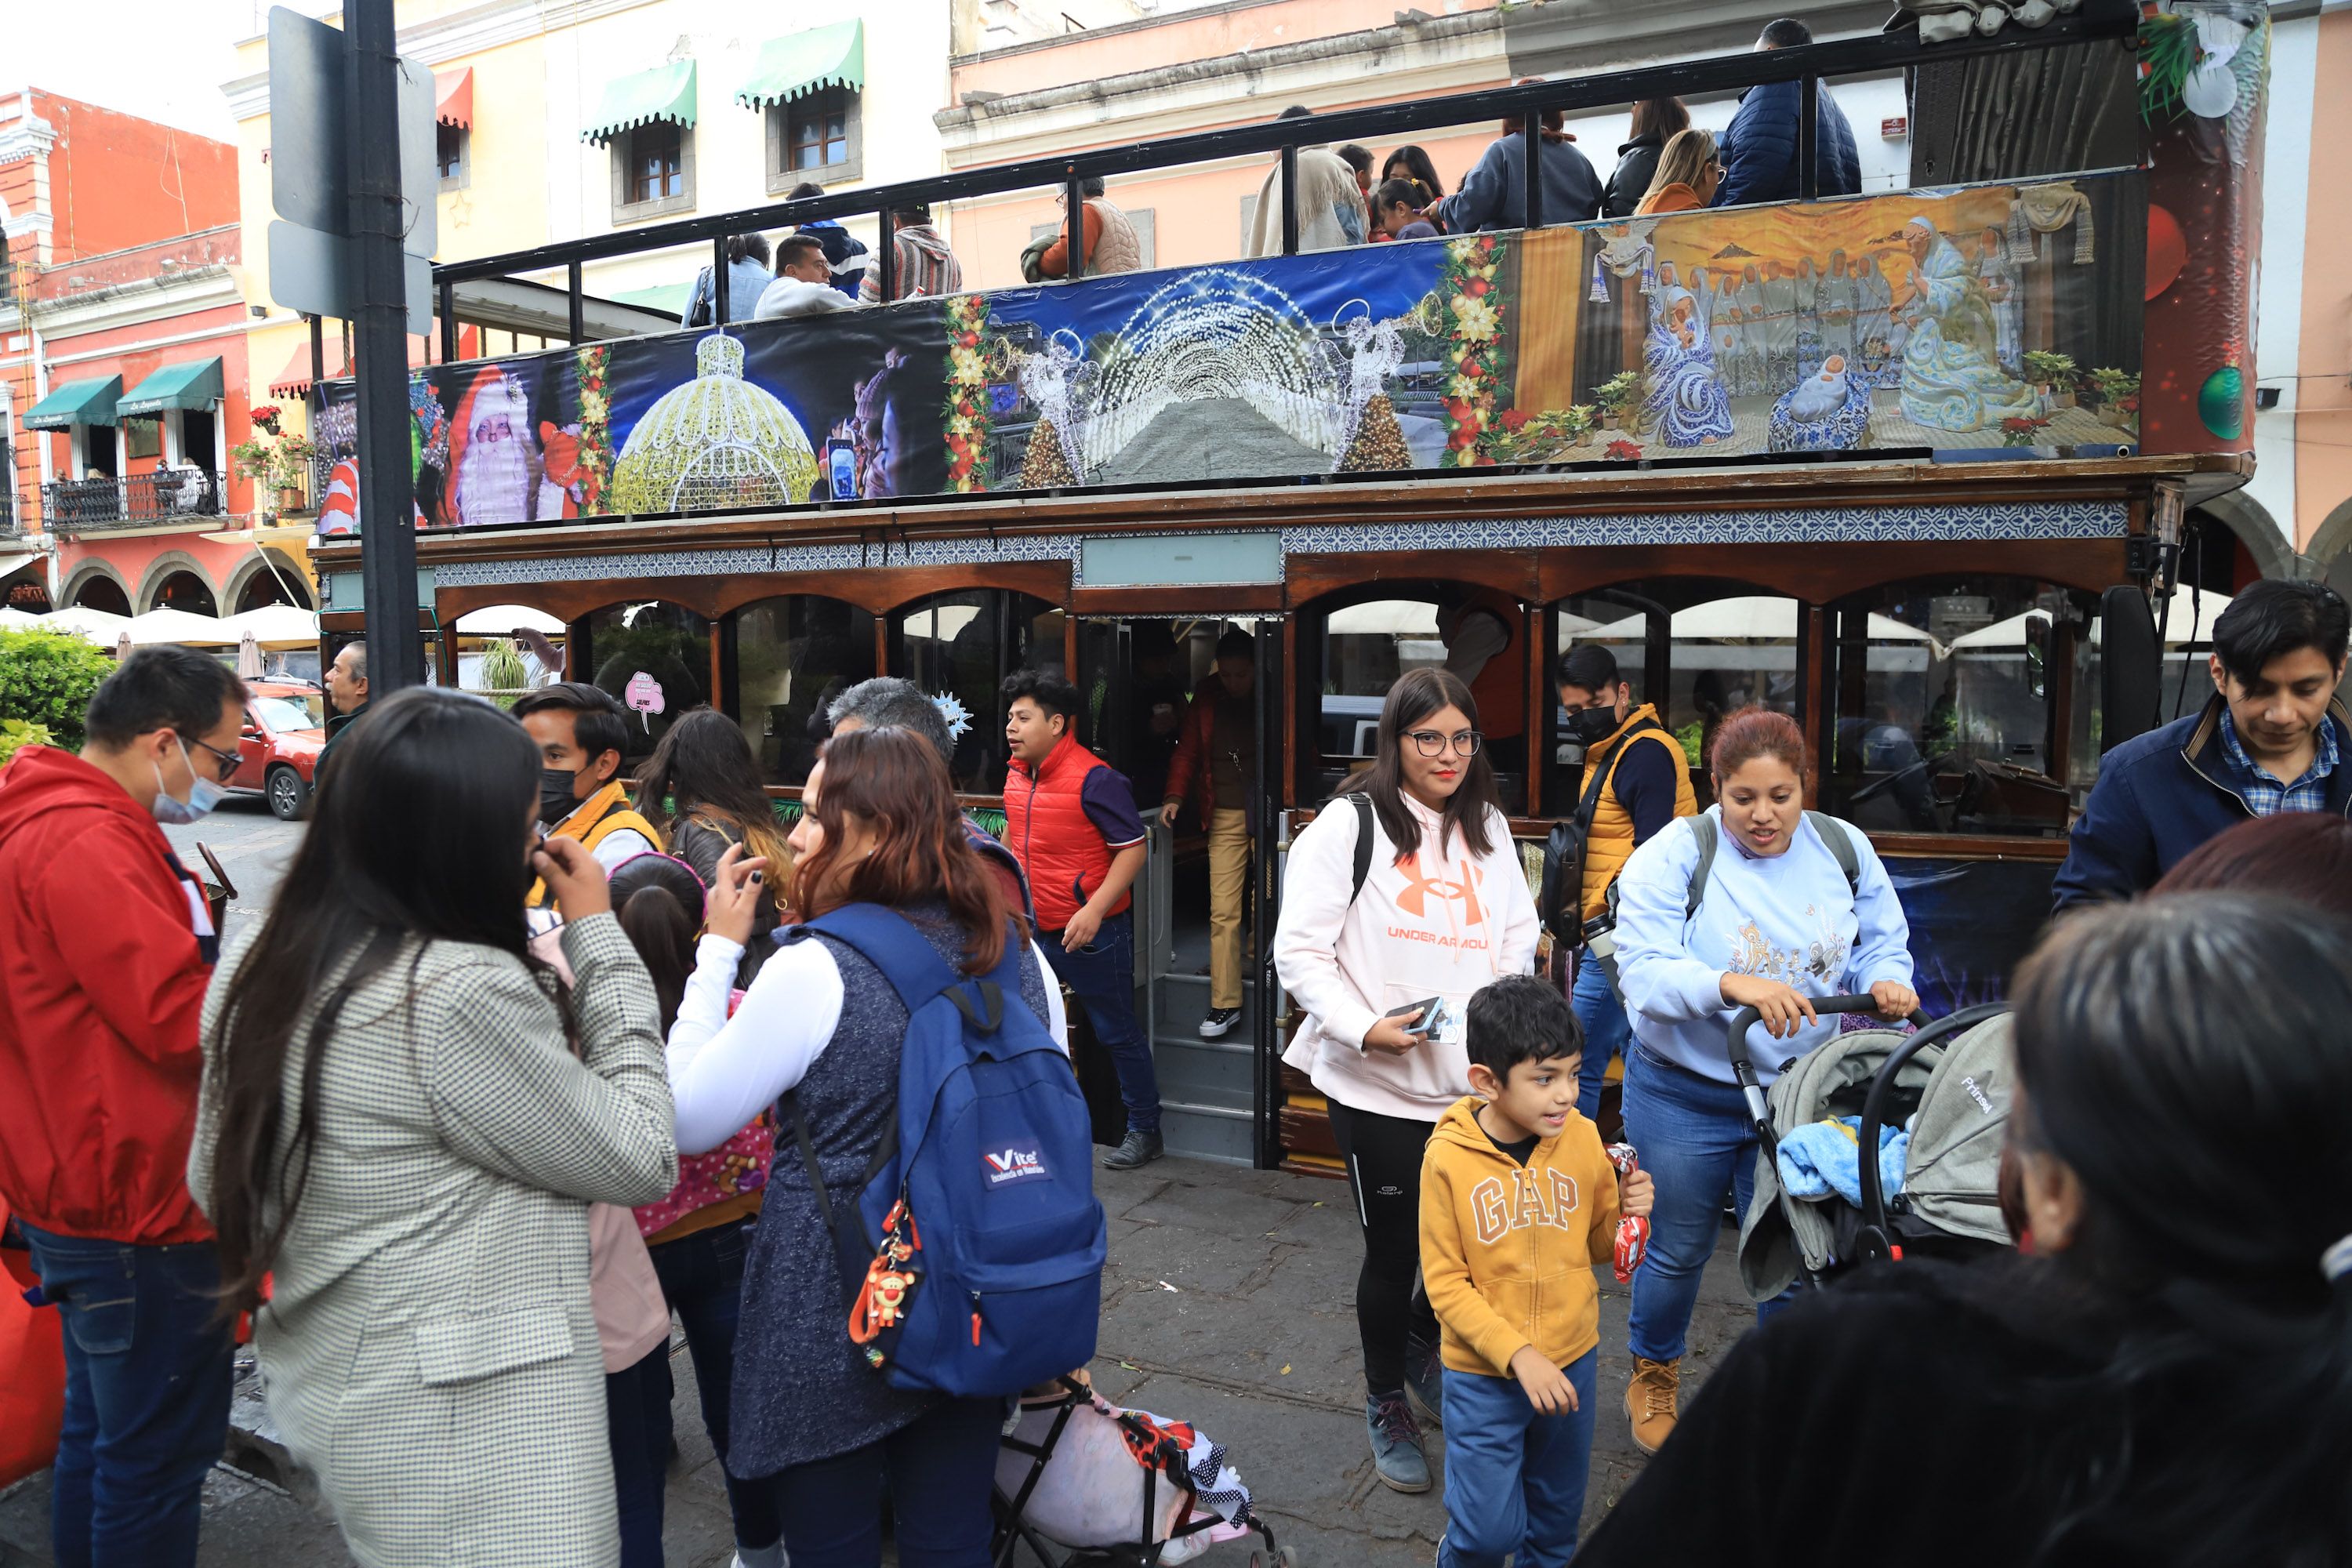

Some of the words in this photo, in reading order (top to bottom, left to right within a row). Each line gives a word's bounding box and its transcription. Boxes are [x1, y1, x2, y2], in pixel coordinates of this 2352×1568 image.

[140, 399, 162, 409] Leyenda
[1388, 926, 1436, 944] UNDER
[1961, 1076, 1992, 1114] Prinsel
[986, 1149, 1037, 1171] Vite
[1470, 1167, 1578, 1244] GAP
